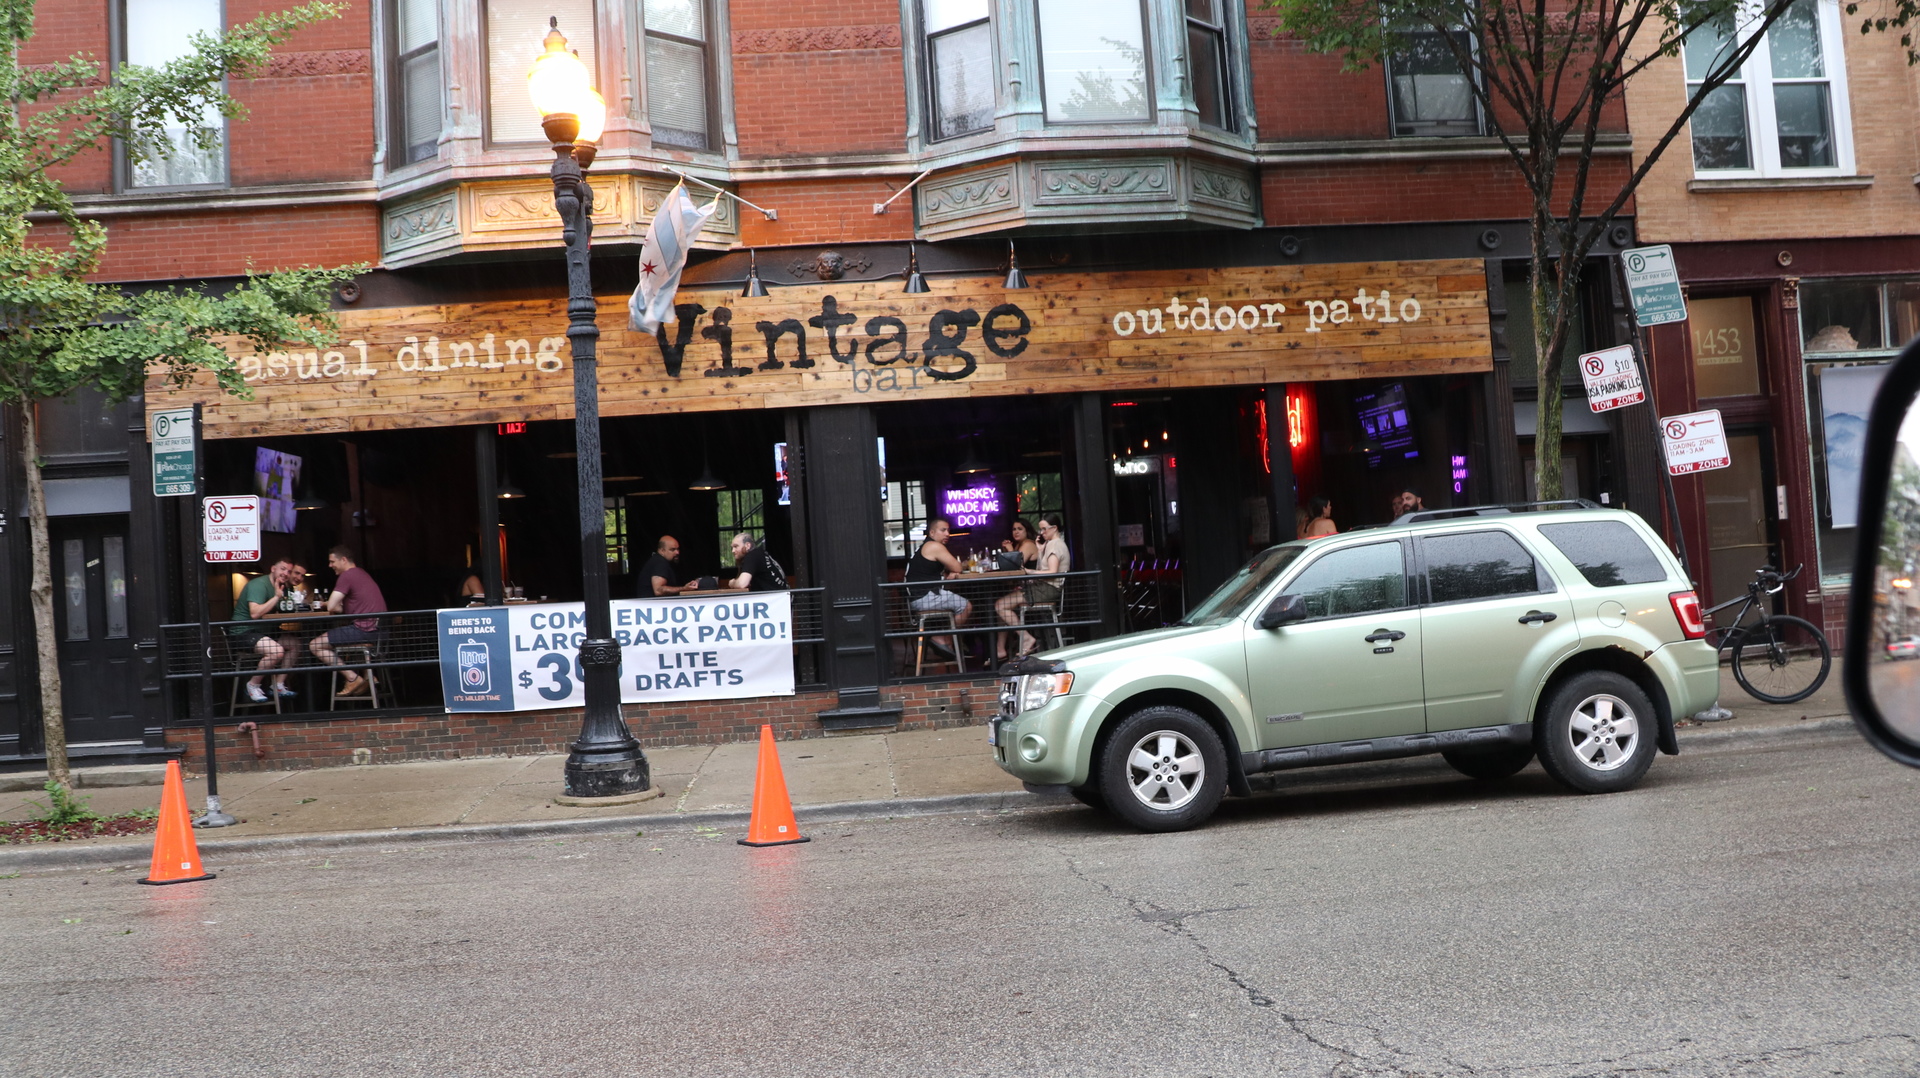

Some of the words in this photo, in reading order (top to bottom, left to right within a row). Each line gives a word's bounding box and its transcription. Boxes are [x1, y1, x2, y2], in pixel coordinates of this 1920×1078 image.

[1113, 296, 1285, 336] outdoor
[1304, 288, 1422, 333] patio
[1651, 314, 1665, 322] 665
[1666, 312, 1680, 320] 309
[656, 295, 1031, 381] Vintage
[1694, 328, 1741, 355] 1453
[214, 340, 377, 381] asual
[397, 332, 566, 373] dining
[1614, 360, 1630, 373] $10
[849, 360, 931, 393] bar
[1589, 379, 1606, 387] VALET
[1609, 373, 1633, 383] LOADING
[1595, 399, 1613, 410] TOW
[1616, 393, 1640, 405] ZONE
[1669, 441, 1696, 450] LOADING
[1699, 438, 1715, 446] ZONE
[1113, 461, 1148, 474] PATIO
[1673, 463, 1693, 473] TOW
[1698, 458, 1724, 470] ZONE
[166, 485, 178, 493] 665
[179, 484, 191, 492] 309
[947, 487, 996, 501] WHISKEY
[945, 501, 979, 514] MADE
[982, 500, 999, 512] ME
[957, 515, 976, 527] DO
[978, 514, 988, 525] IT
[209, 551, 227, 560] TOW
[231, 551, 254, 560] ZONE
[451, 618, 480, 626] HERE'S
[481, 617, 492, 625] TO
[530, 611, 586, 630] COM
[617, 605, 705, 626] ENJOY
[714, 602, 770, 622] OUR
[448, 627, 472, 635] BEING
[474, 626, 496, 634] BACK
[515, 632, 587, 652] LARG
[615, 626, 689, 647] BACK
[698, 622, 786, 643] PATIO!
[461, 651, 487, 667] Lite
[658, 651, 718, 669] LITE
[635, 669, 743, 691] DRAFTS
